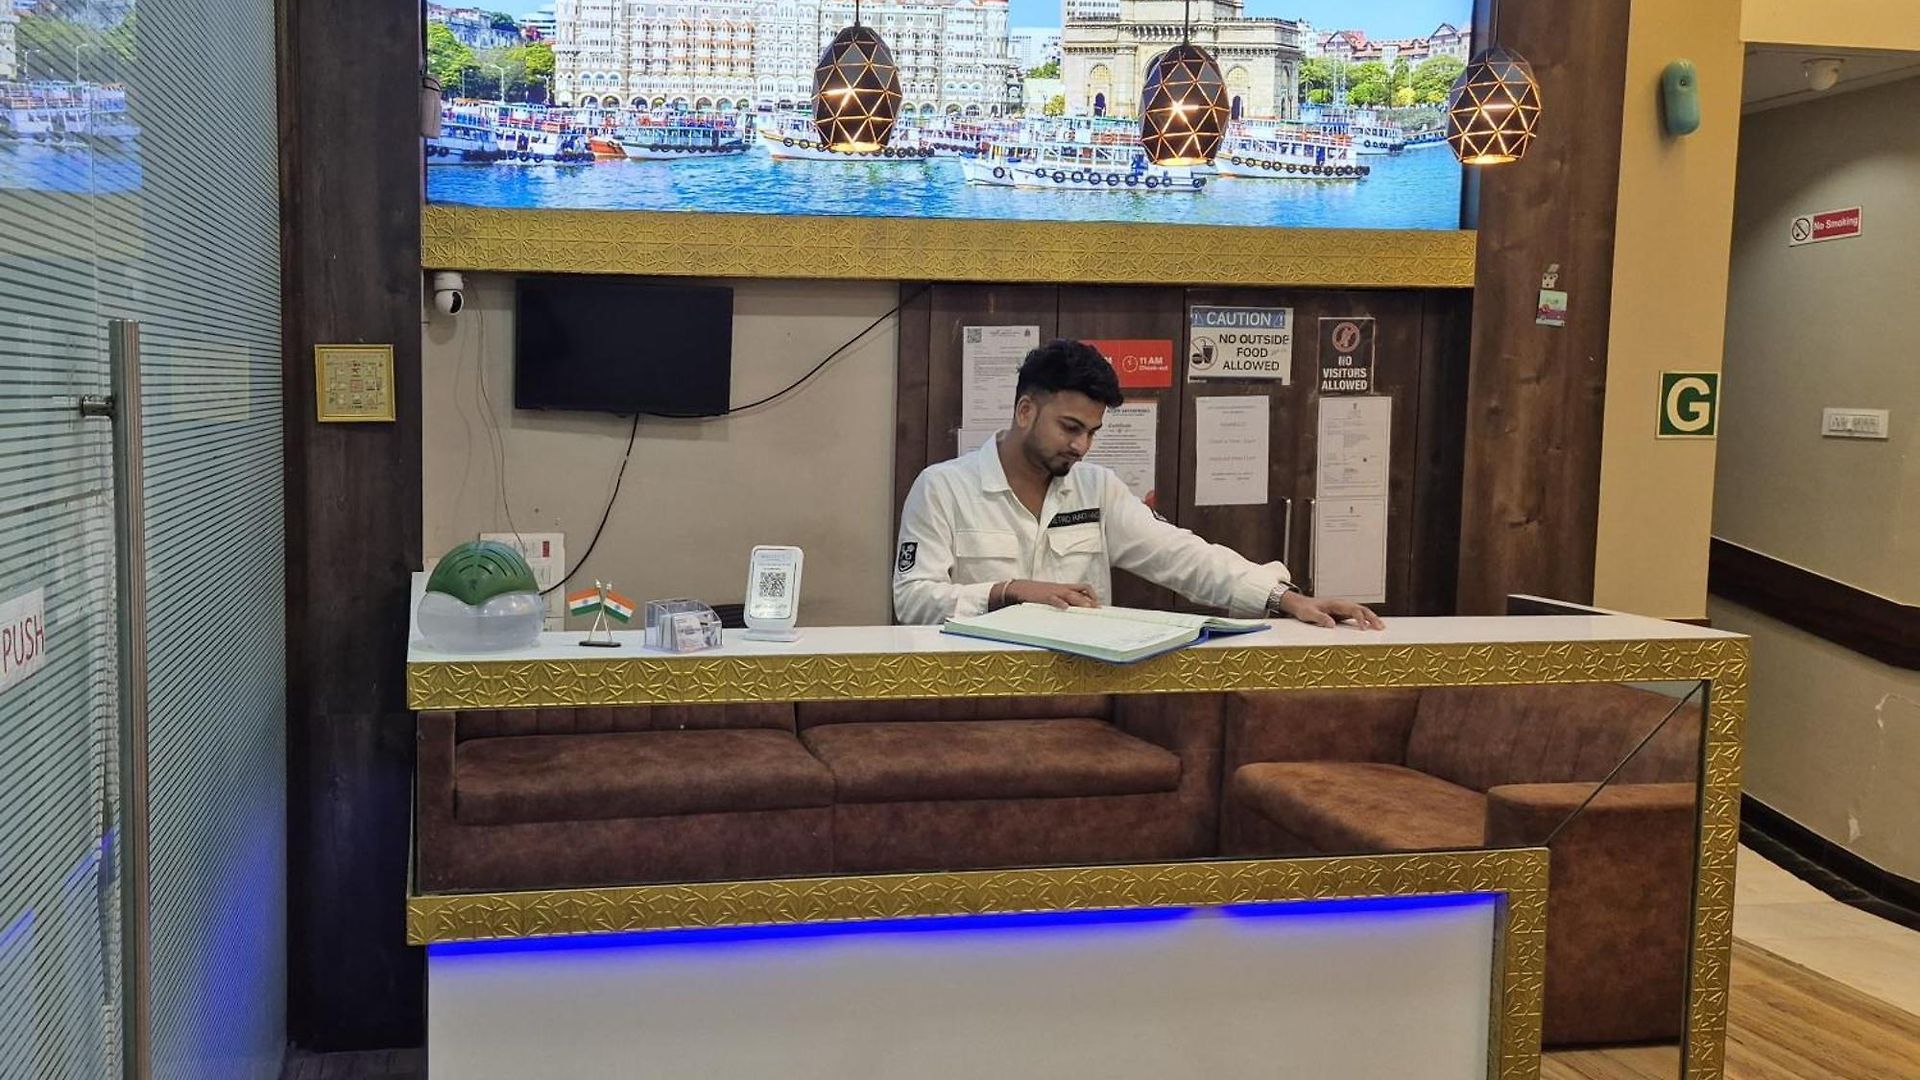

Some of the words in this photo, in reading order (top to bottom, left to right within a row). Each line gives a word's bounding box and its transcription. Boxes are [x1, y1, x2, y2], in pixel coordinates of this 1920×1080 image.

[1813, 221, 1825, 231] No
[1825, 216, 1858, 229] Smoking
[1206, 311, 1271, 326] CAUTION
[1219, 334, 1237, 344] NO
[1239, 334, 1290, 345] OUTSIDE
[1236, 347, 1268, 358] FOOD
[1222, 360, 1280, 371] ALLOWED
[1338, 355, 1353, 366] NO
[1322, 367, 1367, 379] VISITORS
[1321, 380, 1368, 391] ALLOWED
[1666, 377, 1711, 432] G
[2, 610, 45, 675] PUSH
